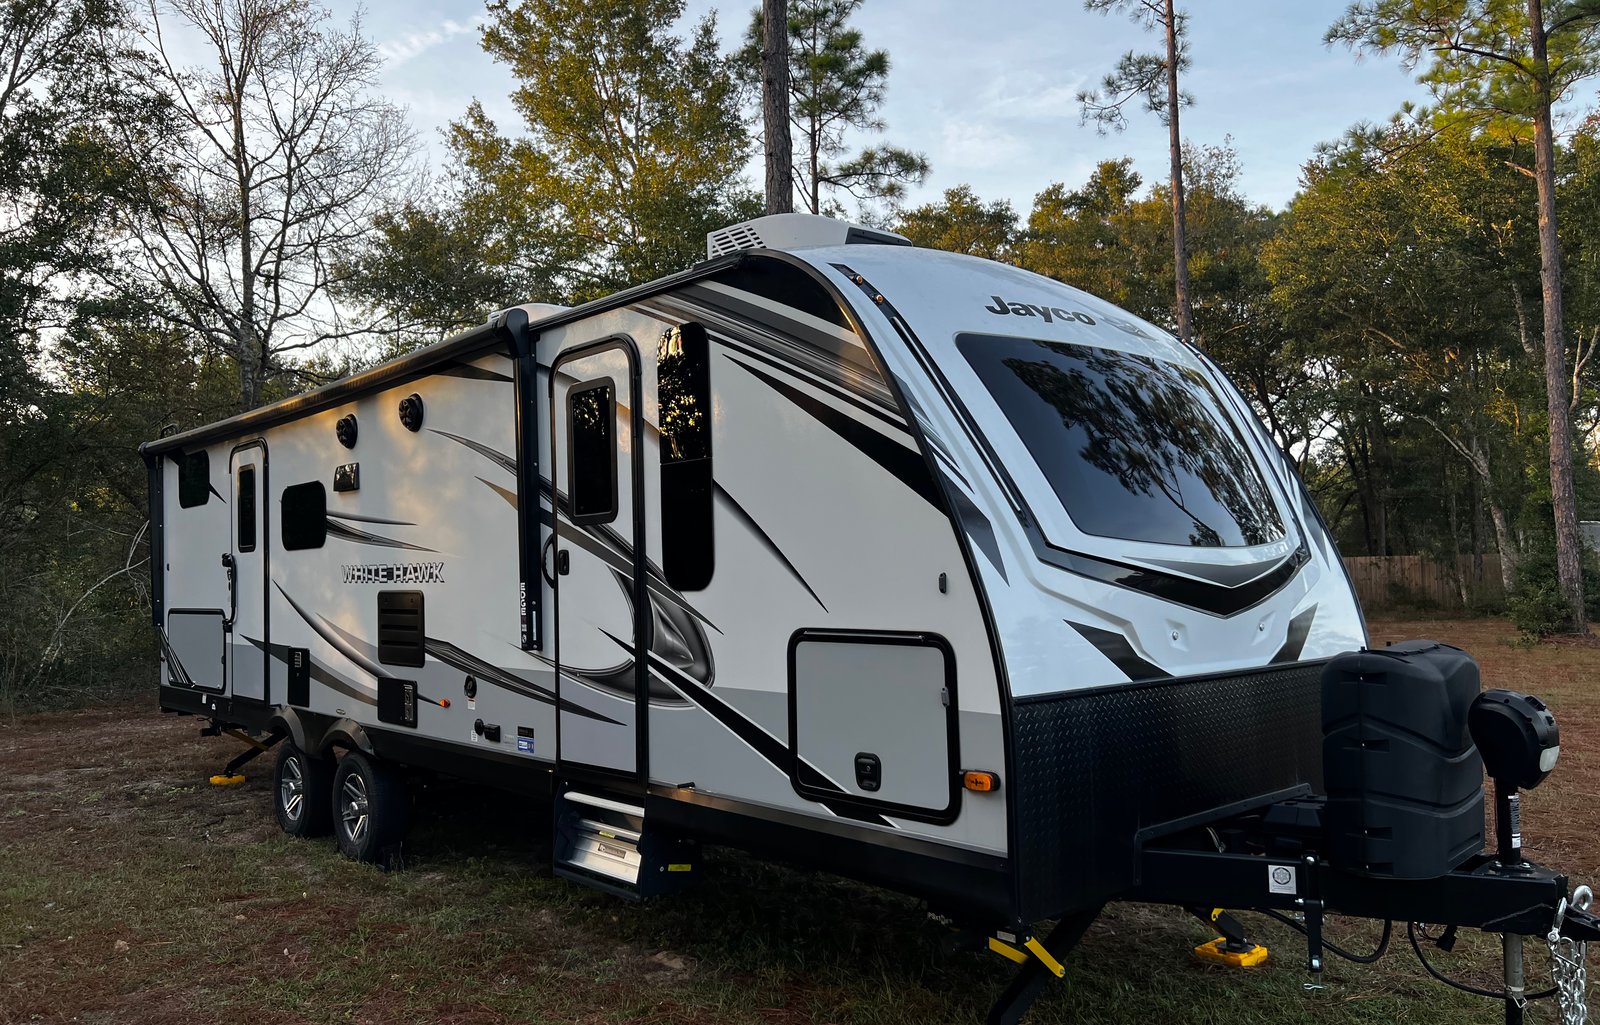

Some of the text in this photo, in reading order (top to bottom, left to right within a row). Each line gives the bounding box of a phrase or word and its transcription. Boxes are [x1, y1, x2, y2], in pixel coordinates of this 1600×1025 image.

[985, 295, 1096, 326] Jayco
[341, 562, 445, 584] WHITE HAWK
